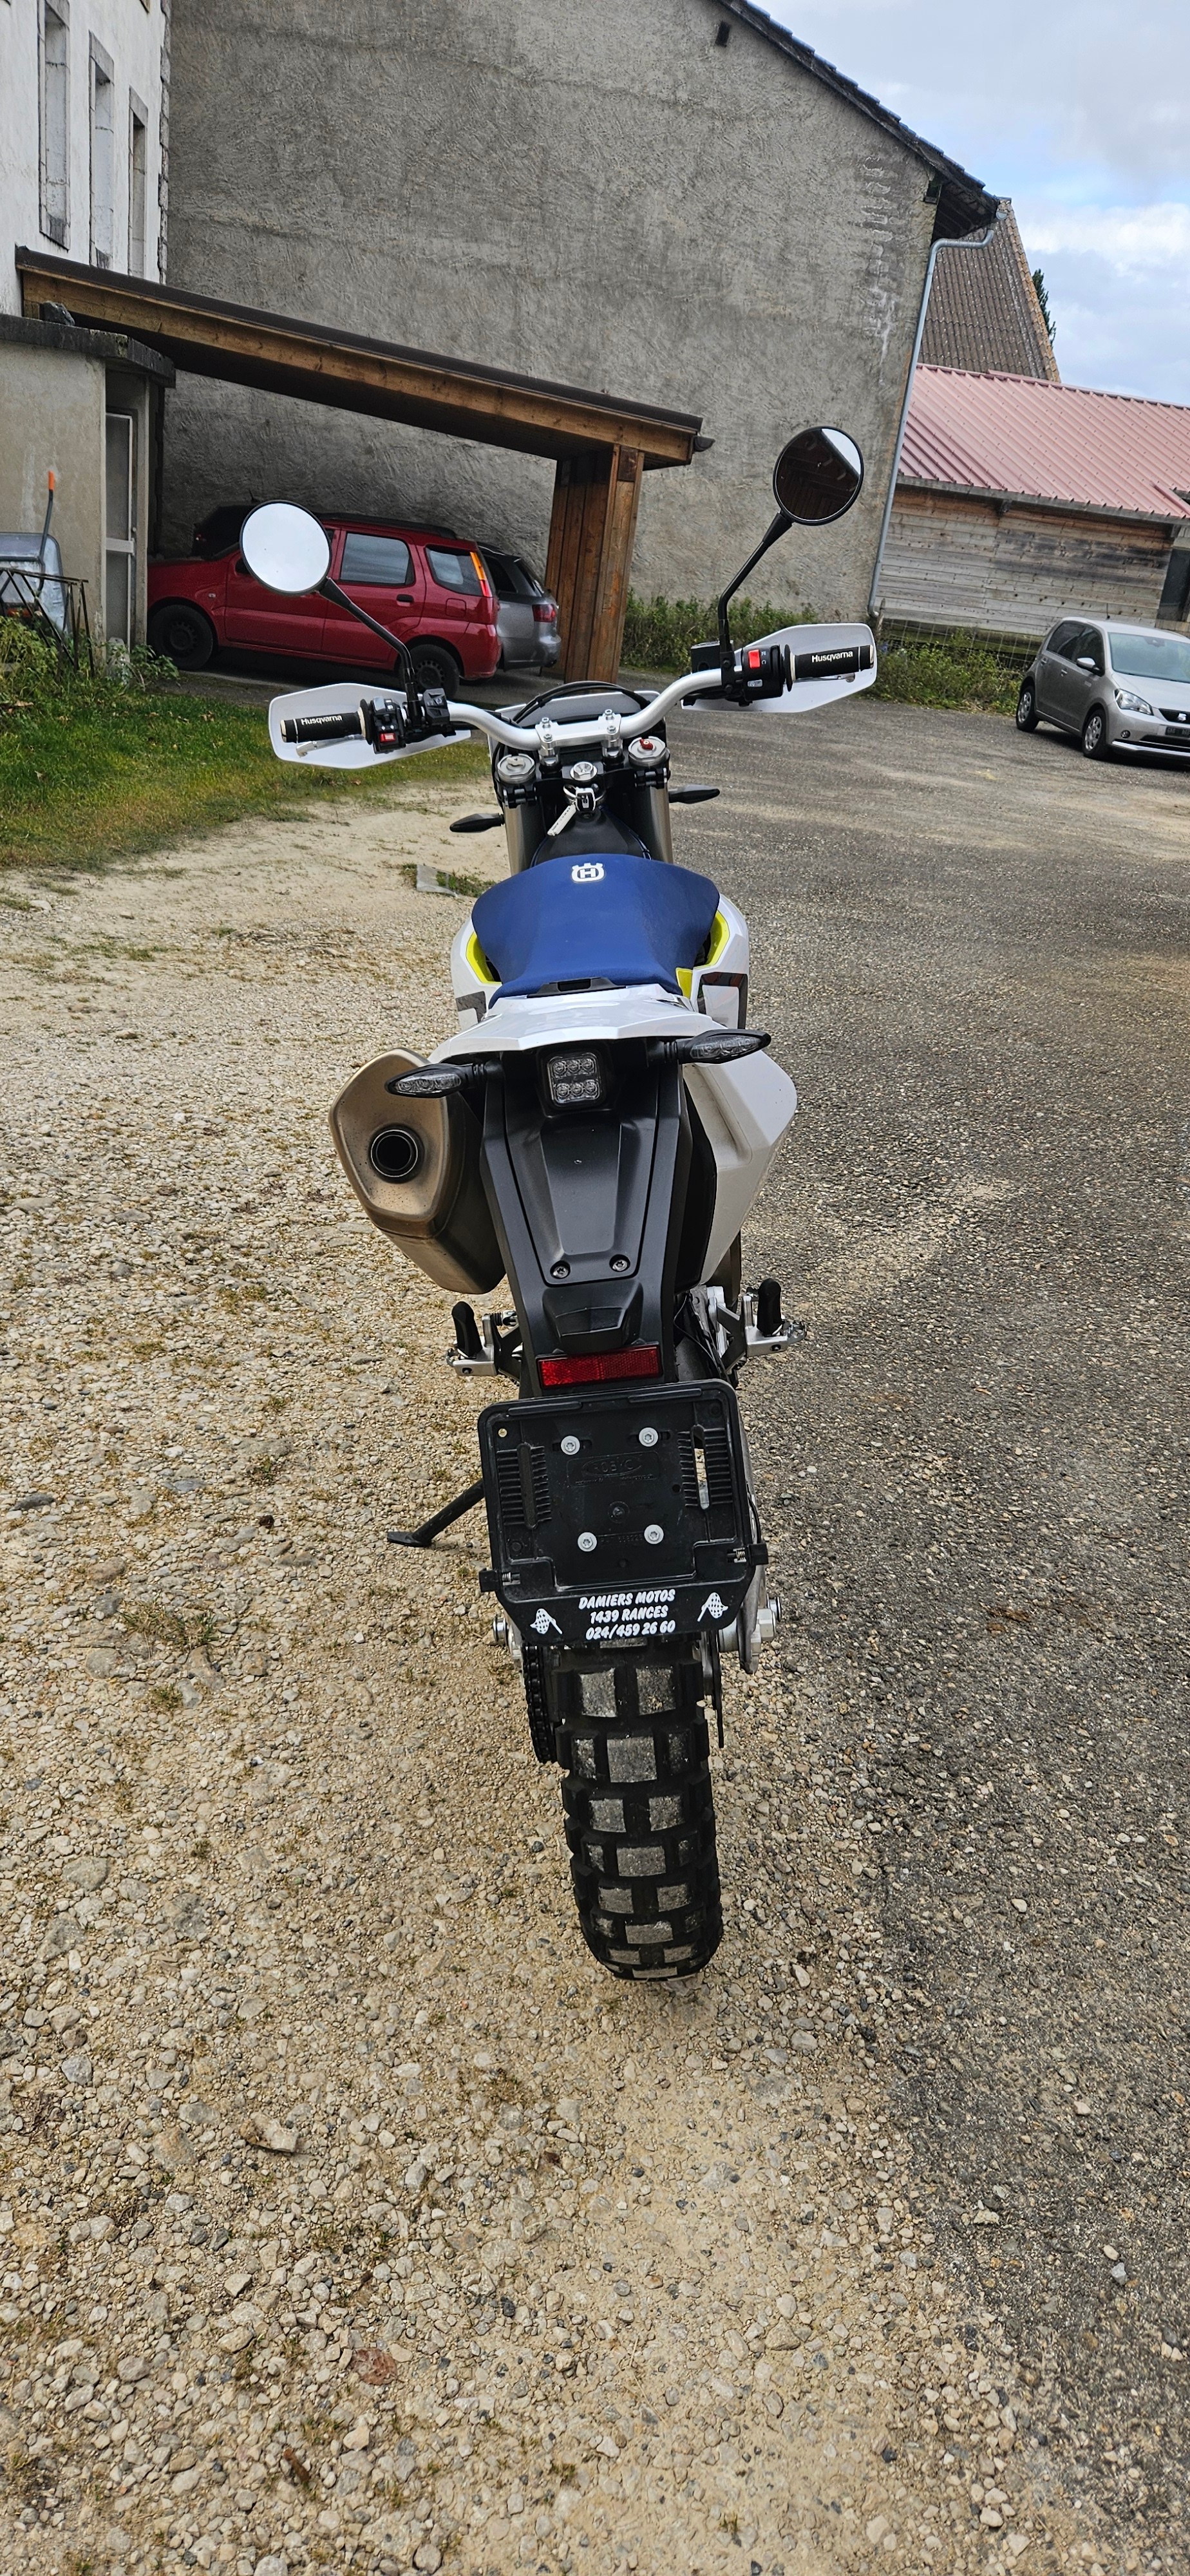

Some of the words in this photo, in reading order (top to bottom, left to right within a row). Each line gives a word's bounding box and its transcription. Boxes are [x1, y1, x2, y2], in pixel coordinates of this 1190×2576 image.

[812, 651, 853, 663] Husqvarna
[301, 715, 343, 725] Husqvarna
[578, 1593, 634, 1610] DAMIERS
[635, 1589, 676, 1604] MOTOS
[590, 1609, 619, 1624] 1439
[621, 1604, 669, 1622] RANCES
[585, 1623, 641, 1640] 024/459
[641, 1621, 658, 1635] 26
[659, 1620, 676, 1634] 60
